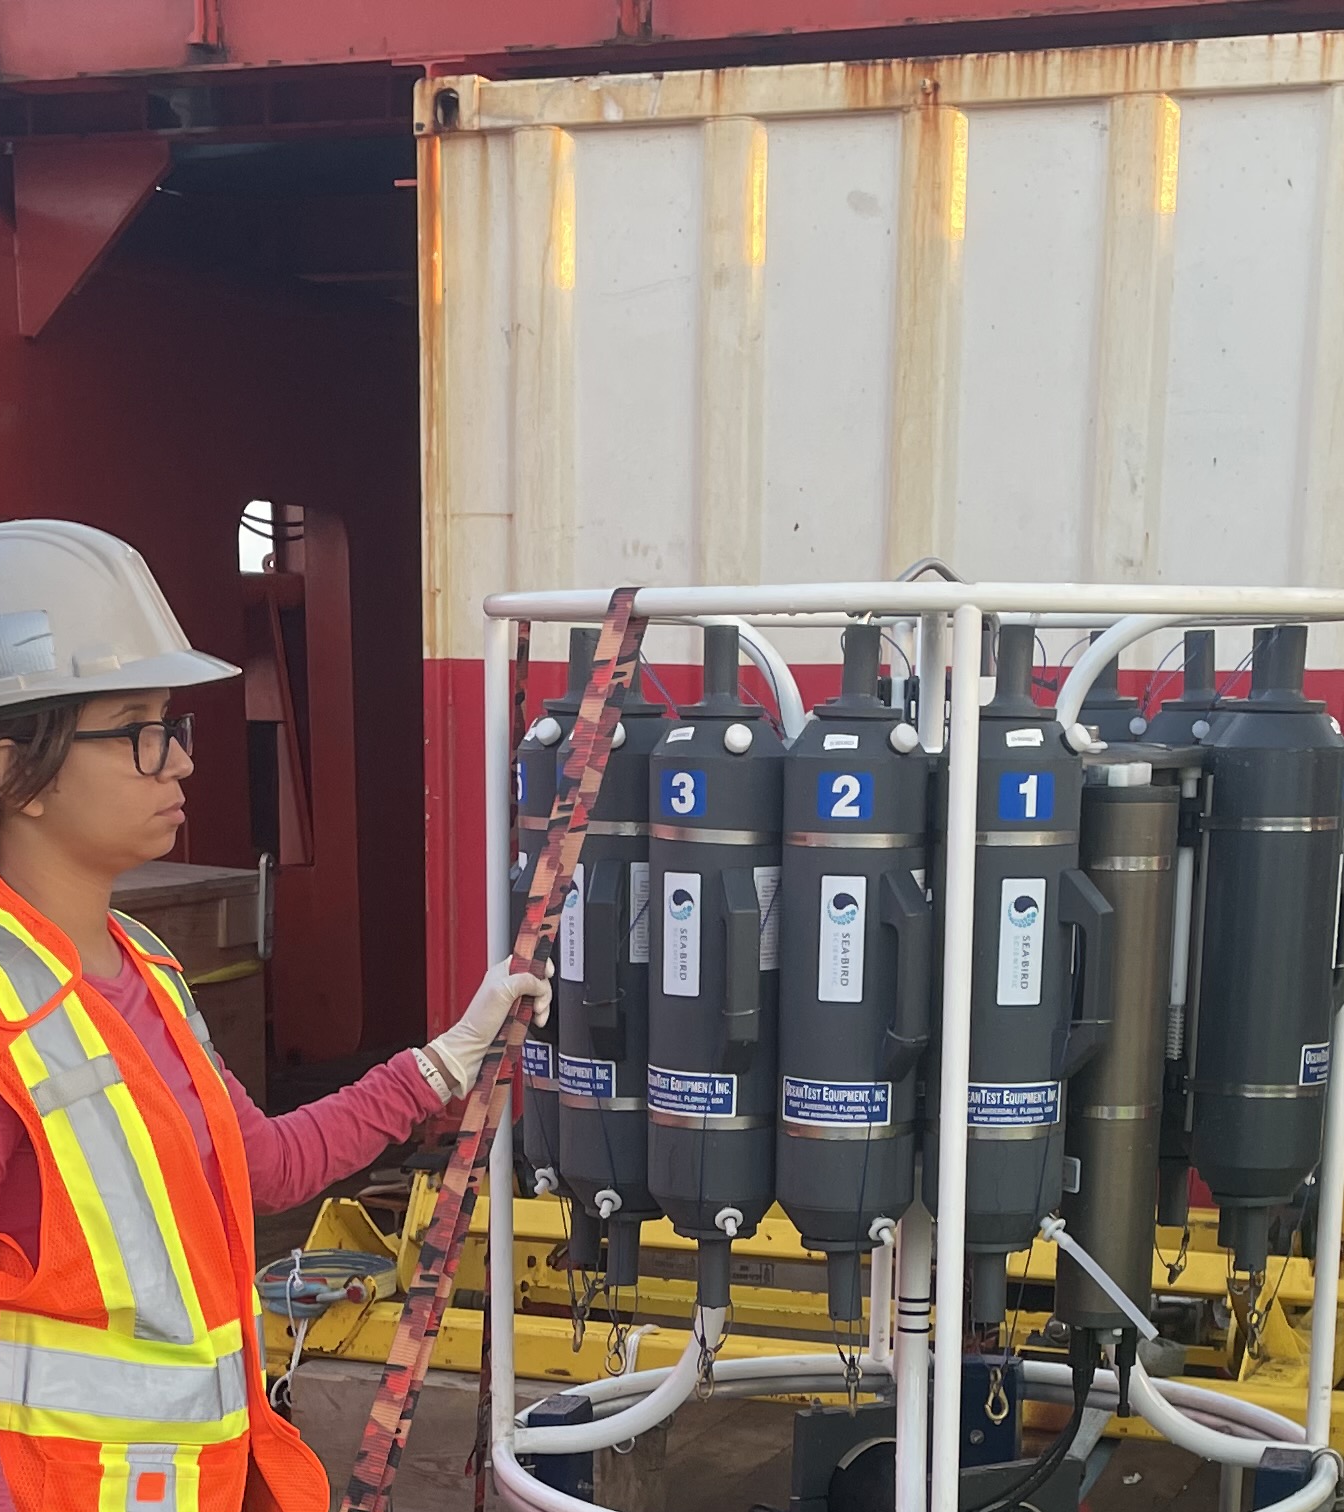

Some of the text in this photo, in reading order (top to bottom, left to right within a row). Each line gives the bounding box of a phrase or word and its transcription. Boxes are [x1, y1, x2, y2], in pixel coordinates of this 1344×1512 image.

[670, 772, 696, 814] 3
[830, 774, 861, 818] 2
[1018, 774, 1038, 818] 1
[715, 1079, 732, 1095] INC.
